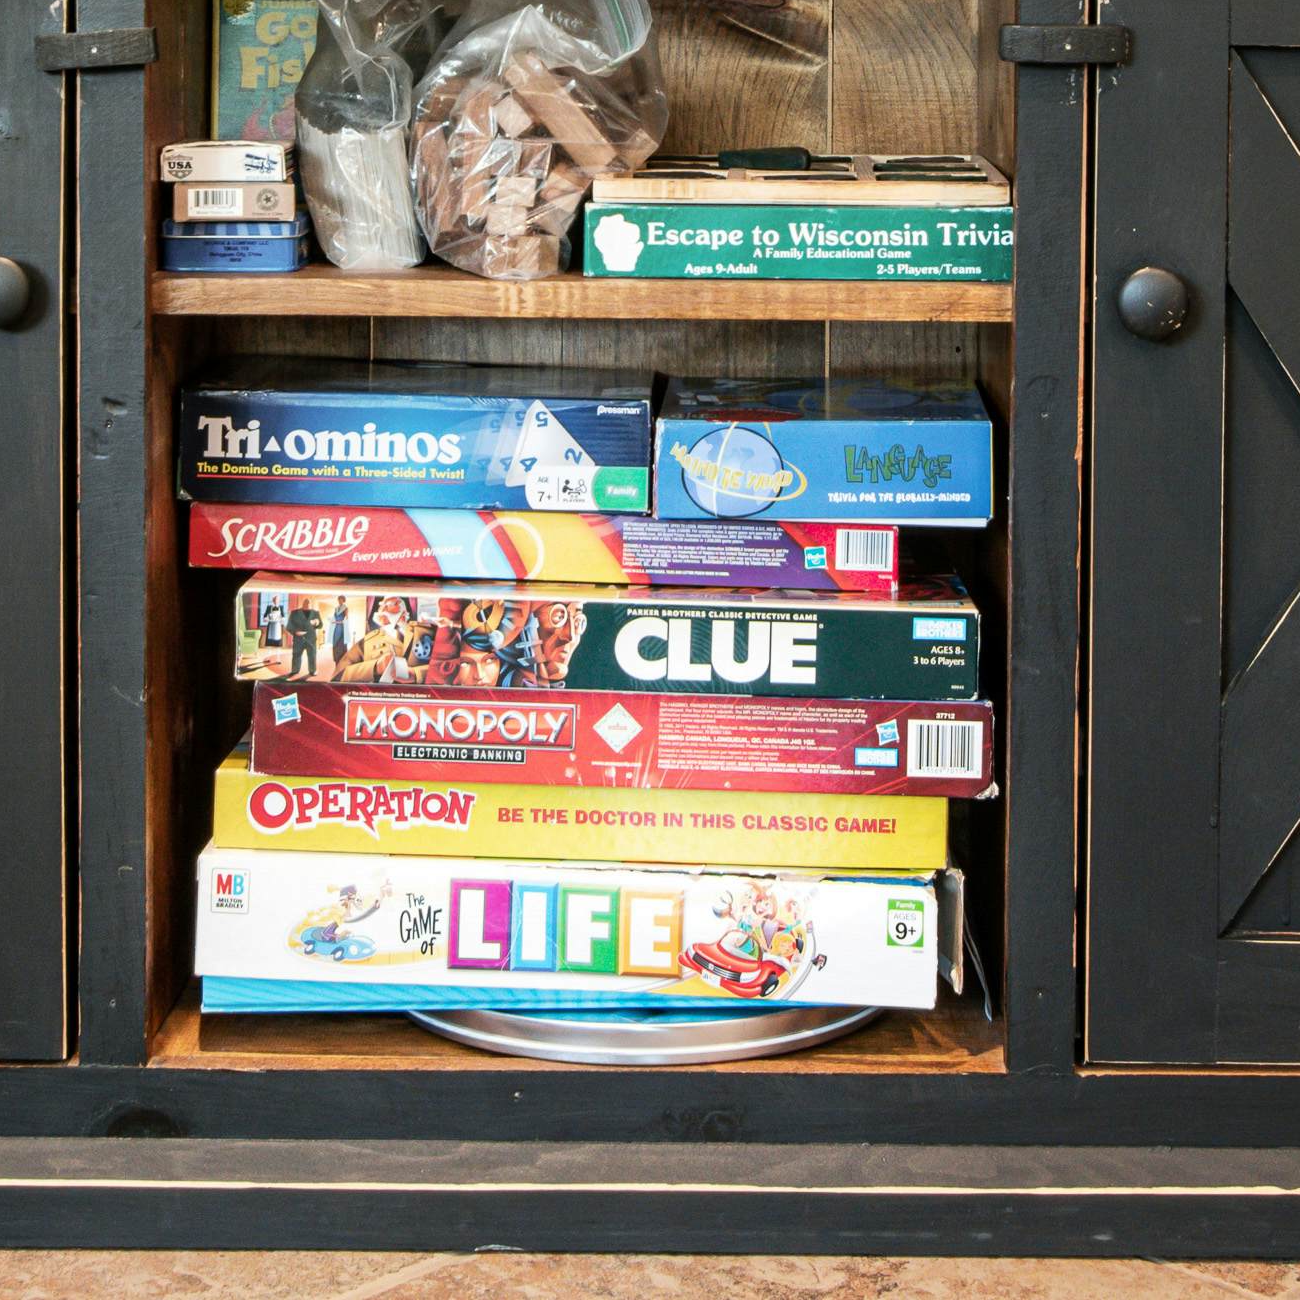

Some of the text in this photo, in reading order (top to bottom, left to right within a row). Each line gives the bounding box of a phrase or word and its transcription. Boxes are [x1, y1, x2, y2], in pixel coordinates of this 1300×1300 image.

[255, 11, 317, 46] Go
[168, 161, 192, 170] USA
[647, 222, 1013, 250] Escape to Wisconsin Trivia
[753, 247, 912, 259] A Family Educational Game
[684, 263, 758, 275] Ages 9-Adult
[876, 263, 982, 276] 2-5 Players/Teams
[197, 461, 465, 480] The Domino Game with a Three-Sided Twist!
[844, 444, 952, 488] LANGUAGE
[607, 485, 638, 497] Family
[208, 515, 370, 558] SCRABBLE
[352, 551, 380, 563] Every
[381, 548, 412, 561] word's
[413, 550, 421, 559] a
[627, 607, 818, 621] PARKER BROTHERS CLASSIC DETECTIVE GAME
[614, 616, 818, 684] CLUE
[931, 645, 965, 655] AGES 8+
[913, 656, 965, 668] 3 to 6 Players
[355, 704, 569, 743] MONOPOLY
[936, 712, 956, 720] 37712
[397, 746, 523, 761] ELECTRONIC BANKING
[250, 782, 475, 832] OPERATION
[497, 807, 897, 834] BE THE DOCTOR IN THIS CLASSIC GAME!
[216, 873, 245, 896] MB
[215, 902, 245, 910] BRADLEY
[406, 893, 426, 910] The
[399, 906, 443, 944] GAME
[457, 887, 676, 968] LIFE
[895, 921, 917, 941] 9+
[420, 937, 438, 956] of
